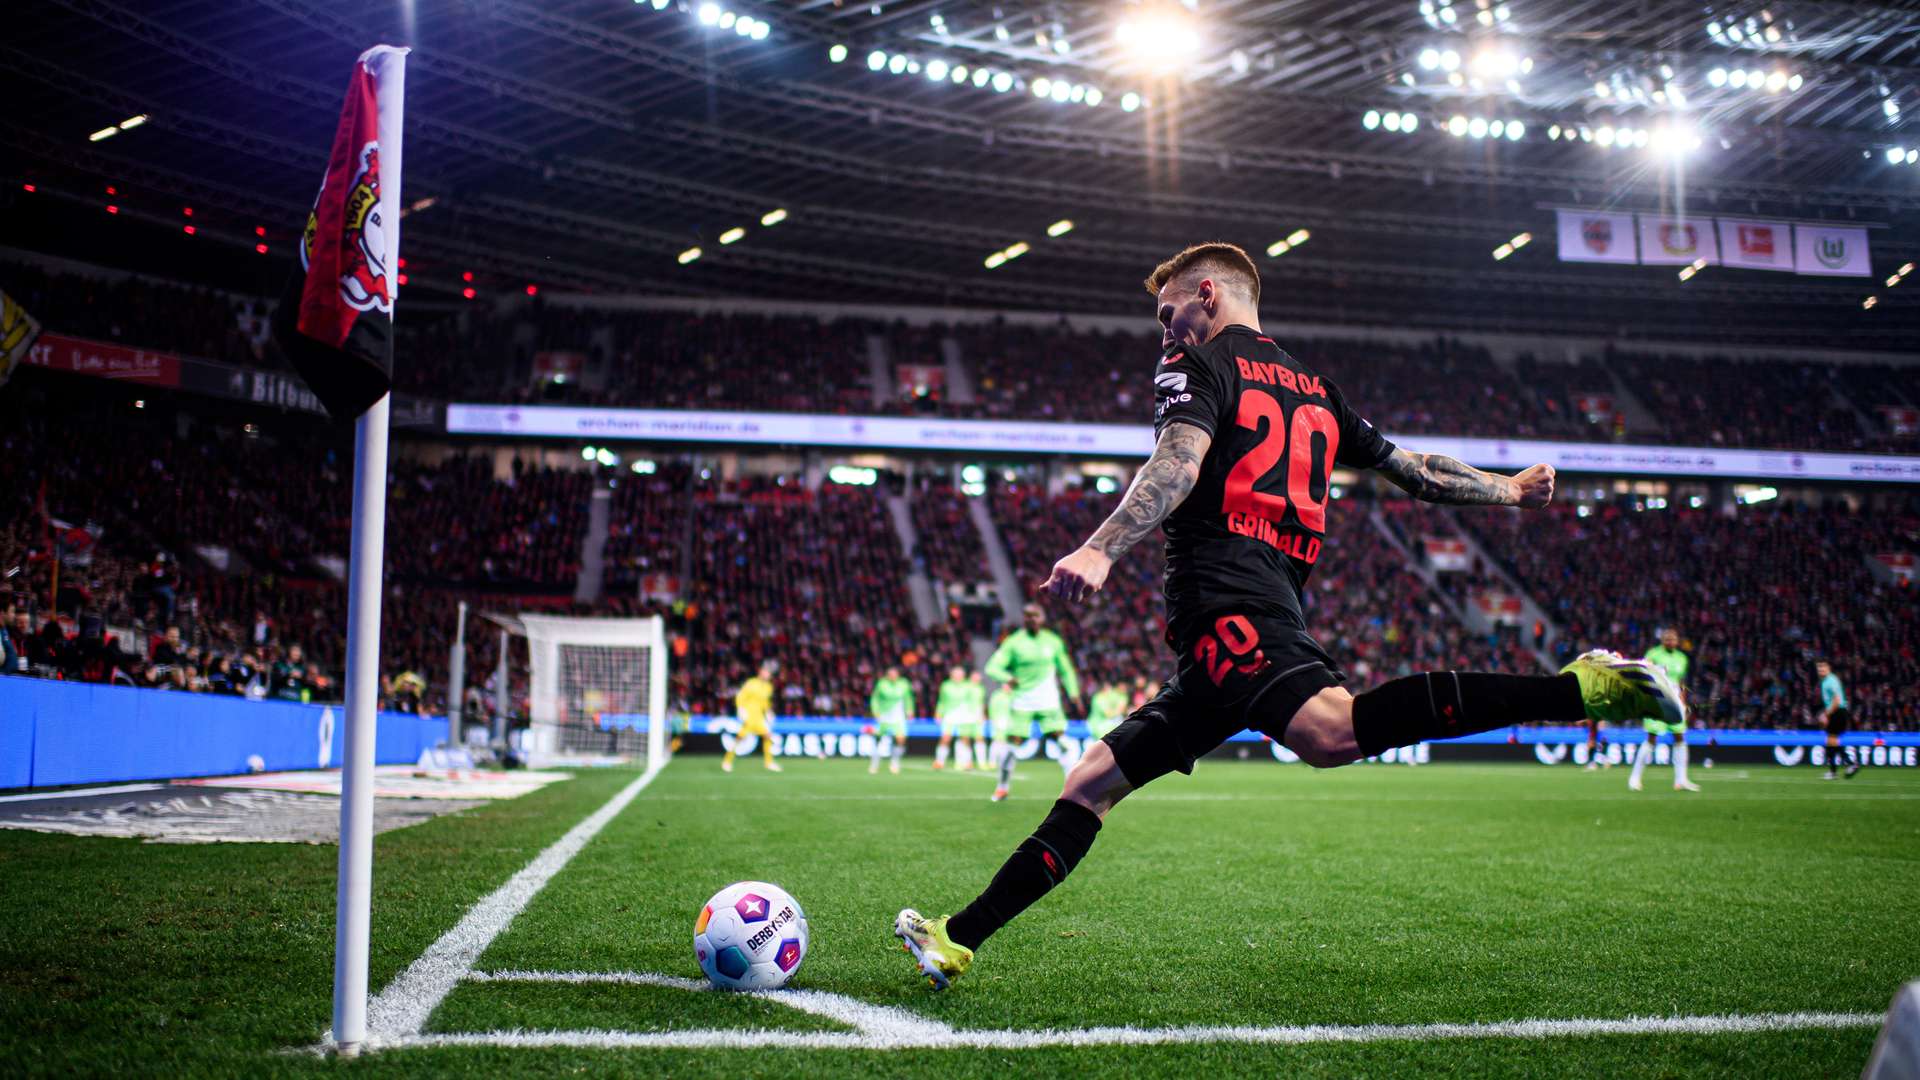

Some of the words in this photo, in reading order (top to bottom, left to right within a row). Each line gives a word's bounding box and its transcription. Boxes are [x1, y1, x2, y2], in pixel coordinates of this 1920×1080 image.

[1235, 356, 1300, 393] BAYER
[1297, 373, 1326, 399] 04
[1221, 388, 1340, 534] 20
[1194, 614, 1260, 688] 20
[746, 906, 794, 951] DERBYSTAR
